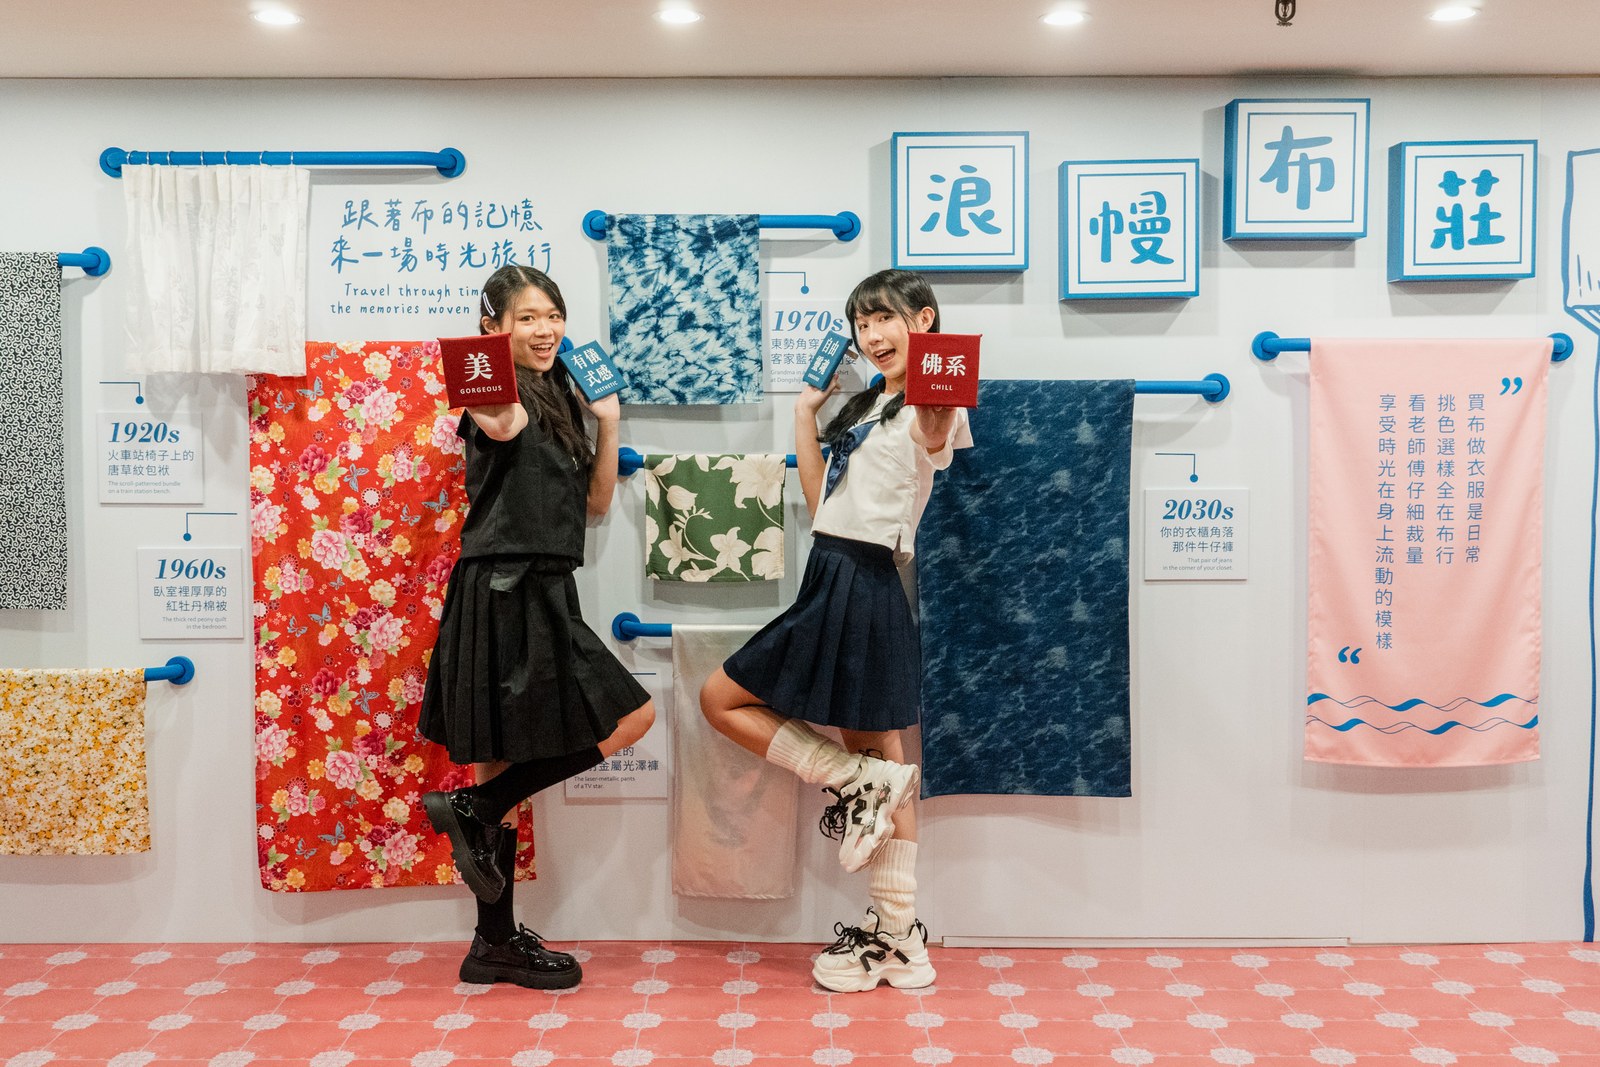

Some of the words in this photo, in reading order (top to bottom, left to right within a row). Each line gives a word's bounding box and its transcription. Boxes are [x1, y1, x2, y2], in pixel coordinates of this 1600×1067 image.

[920, 164, 1002, 238] 浪
[1089, 190, 1175, 265] 幔
[1259, 125, 1335, 210] 布
[1430, 170, 1506, 251] 莊
[341, 197, 544, 235] 跟著布的記憶
[330, 234, 552, 275] 來一場時光旅行
[344, 283, 390, 297] Travel
[398, 283, 451, 302] through
[458, 284, 483, 297] tim
[330, 301, 351, 314] the
[360, 303, 420, 315] memories
[428, 304, 471, 314] woven
[771, 310, 844, 332] 1970s
[771, 338, 824, 350] 東勢角穿
[464, 352, 494, 382] 美
[583, 364, 614, 387] 式感
[920, 352, 967, 377] 佛系
[460, 385, 503, 395] GORGEOUS
[931, 383, 953, 391] CHILL
[108, 421, 180, 444] 1920s
[108, 449, 194, 462] 火車站椅子上的
[1405, 393, 1426, 565] 看老師傅仔細裁量
[1435, 393, 1457, 565] 挑色選樣全在布行
[1465, 393, 1486, 564] 買布做衣服是日常
[1162, 499, 1234, 520] 2030s
[1160, 526, 1234, 538] 你的衣櫃角落
[1375, 393, 1397, 650] 享受時光在身上流動的模樣
[1172, 541, 1234, 553] 那件牛仔褲
[154, 558, 227, 580] 1960s
[166, 600, 227, 612] 紅牡丹棉被
